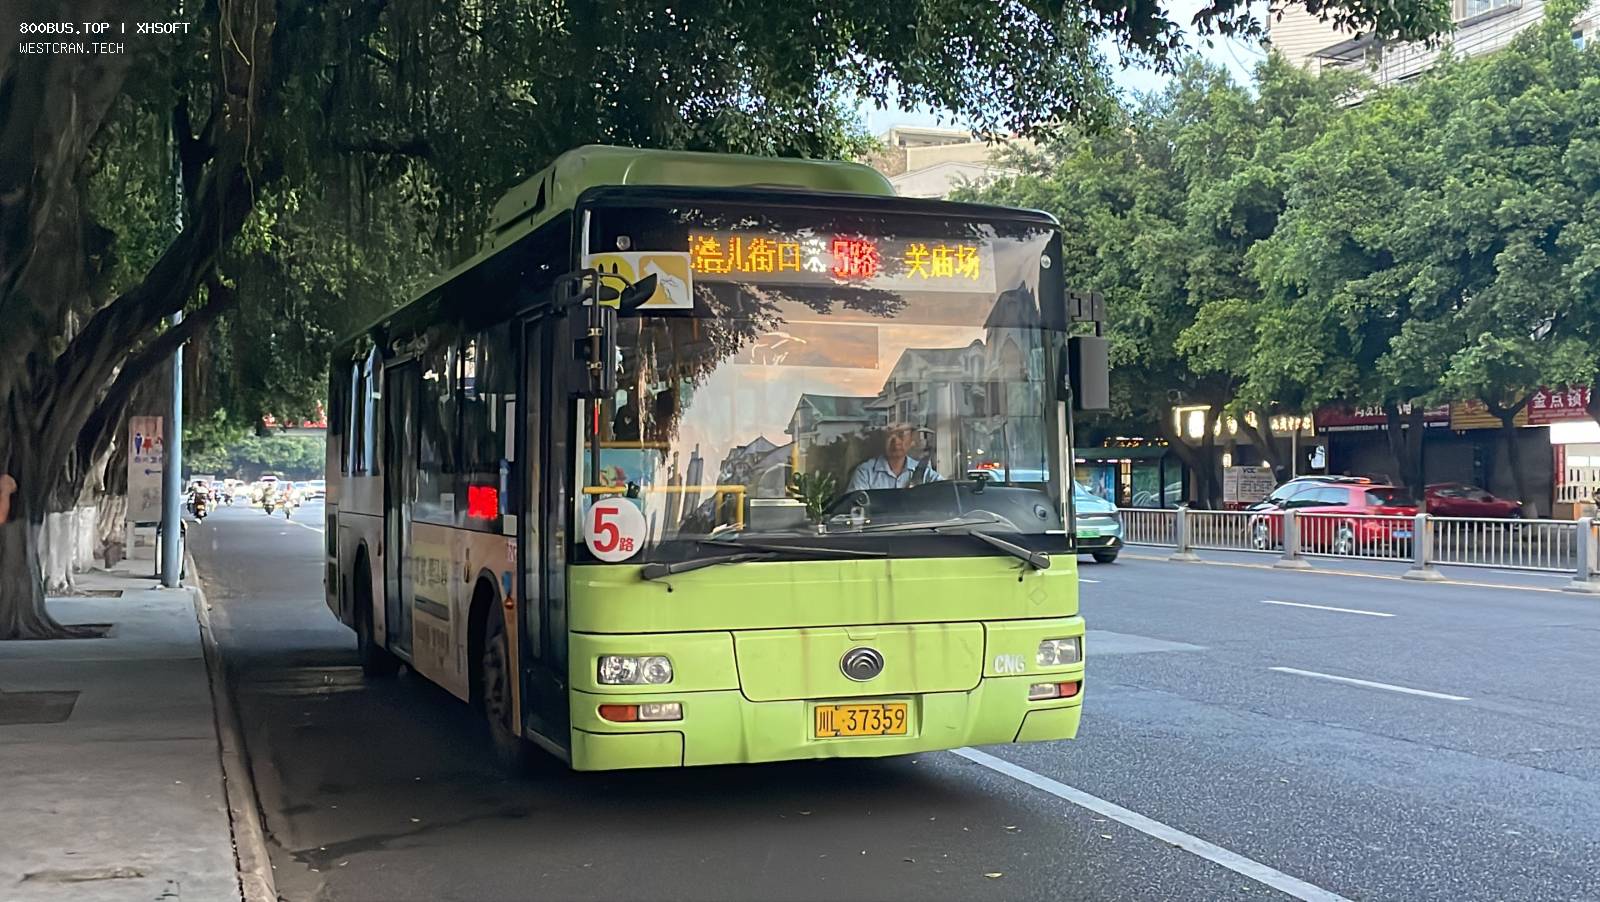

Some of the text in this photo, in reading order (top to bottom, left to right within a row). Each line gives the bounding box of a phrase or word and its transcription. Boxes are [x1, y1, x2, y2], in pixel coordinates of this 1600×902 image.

[903, 242, 981, 281] 关庙场
[993, 655, 1026, 674] CNG
